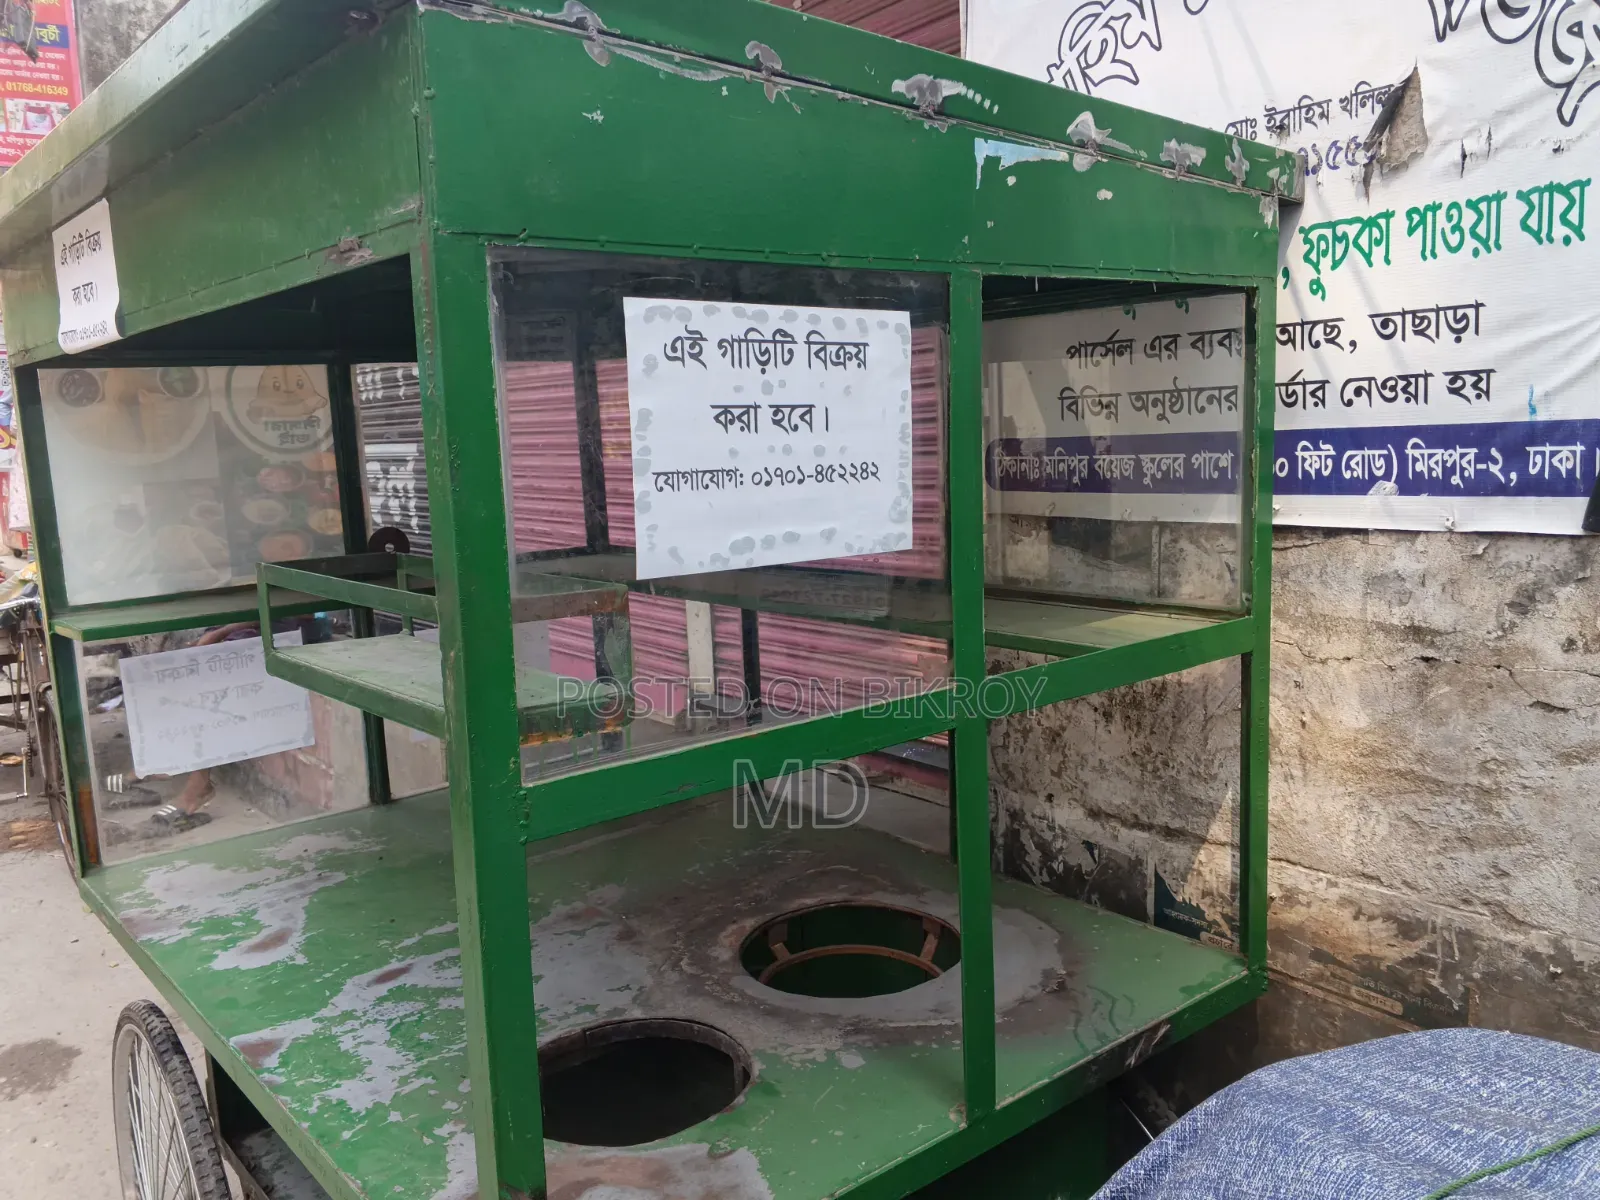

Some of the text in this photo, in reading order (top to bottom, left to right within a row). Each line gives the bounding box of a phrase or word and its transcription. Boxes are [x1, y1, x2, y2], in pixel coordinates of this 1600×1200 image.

[6, 80, 68, 96] 01768-416349
[1299, 177, 1592, 301] ফুচকা পাওয়া যায়
[663, 324, 870, 375] এই গাড়িটি বিক্রয়
[1066, 329, 1136, 370] পার্সেল
[1143, 333, 1181, 363] এর
[1276, 317, 1357, 353] আছে,
[1368, 300, 1486, 344] তাছাড়া
[710, 401, 761, 434] করা
[768, 404, 816, 435] হবে
[1057, 368, 1497, 424] বিভিন্ন অনুষ্ঠানের র্ডার নেওয়া হয়
[652, 460, 881, 493] যোগাযোগ: ০১৭০১-৪৫২২৪২
[1043, 446, 1089, 484] মনিপুর
[1094, 453, 1135, 480] বয়েজ
[1139, 452, 1186, 487] স্কুলের
[1295, 440, 1336, 480] ফিট
[1341, 444, 1398, 484] রোড)
[1405, 438, 1517, 488] মিরপুর-২,
[1526, 442, 1585, 480] ঢাকা
